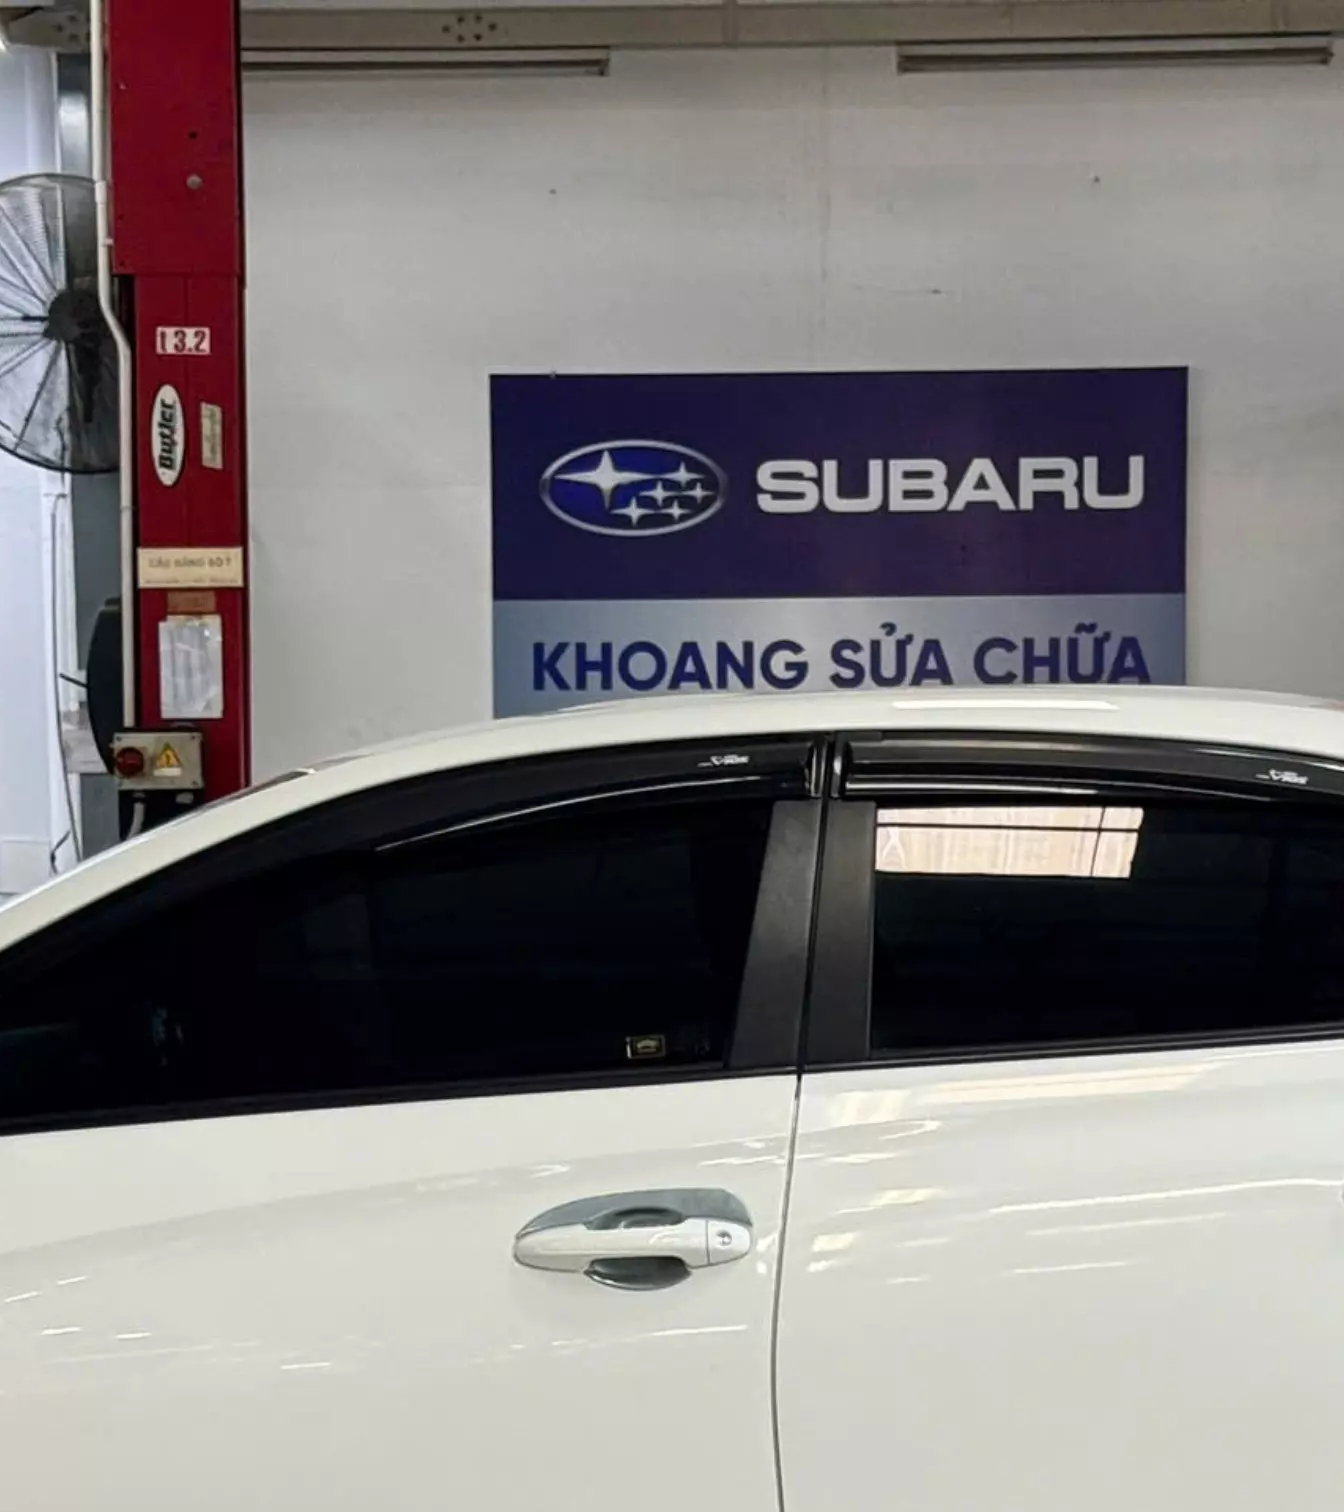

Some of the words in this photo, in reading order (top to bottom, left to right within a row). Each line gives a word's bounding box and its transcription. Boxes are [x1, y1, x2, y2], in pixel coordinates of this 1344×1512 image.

[173, 329, 208, 353] 3.2
[157, 397, 177, 471] Butler
[756, 454, 1145, 514] SUBARU
[532, 638, 810, 692] KHOANG
[828, 622, 955, 689] SỬA
[973, 622, 1152, 685] CHỮA
